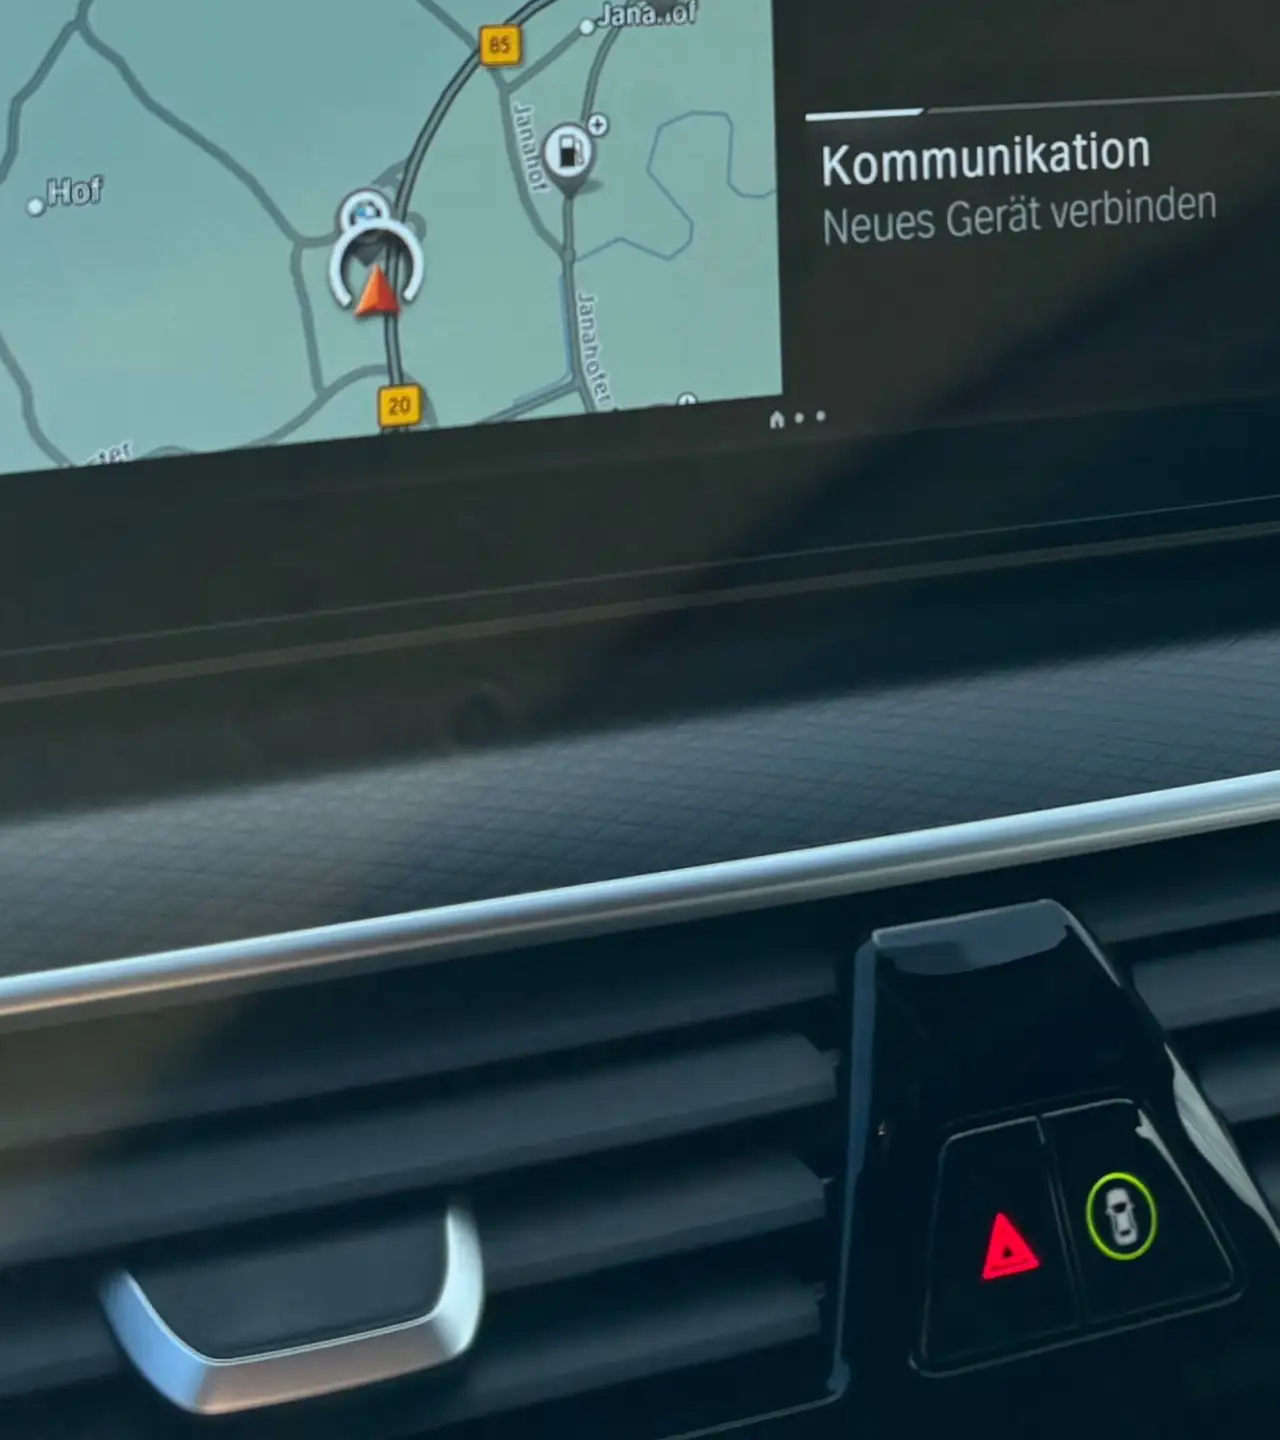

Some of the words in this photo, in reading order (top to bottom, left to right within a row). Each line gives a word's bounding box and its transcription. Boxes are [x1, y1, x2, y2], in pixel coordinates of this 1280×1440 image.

[488, 34, 512, 55] 85
[822, 133, 1151, 188] Kommunikation
[47, 175, 104, 206] Hof
[824, 204, 935, 246] Neues
[946, 194, 1042, 238] Gerät
[1050, 188, 1218, 231] verbinden
[387, 394, 411, 416] 20
